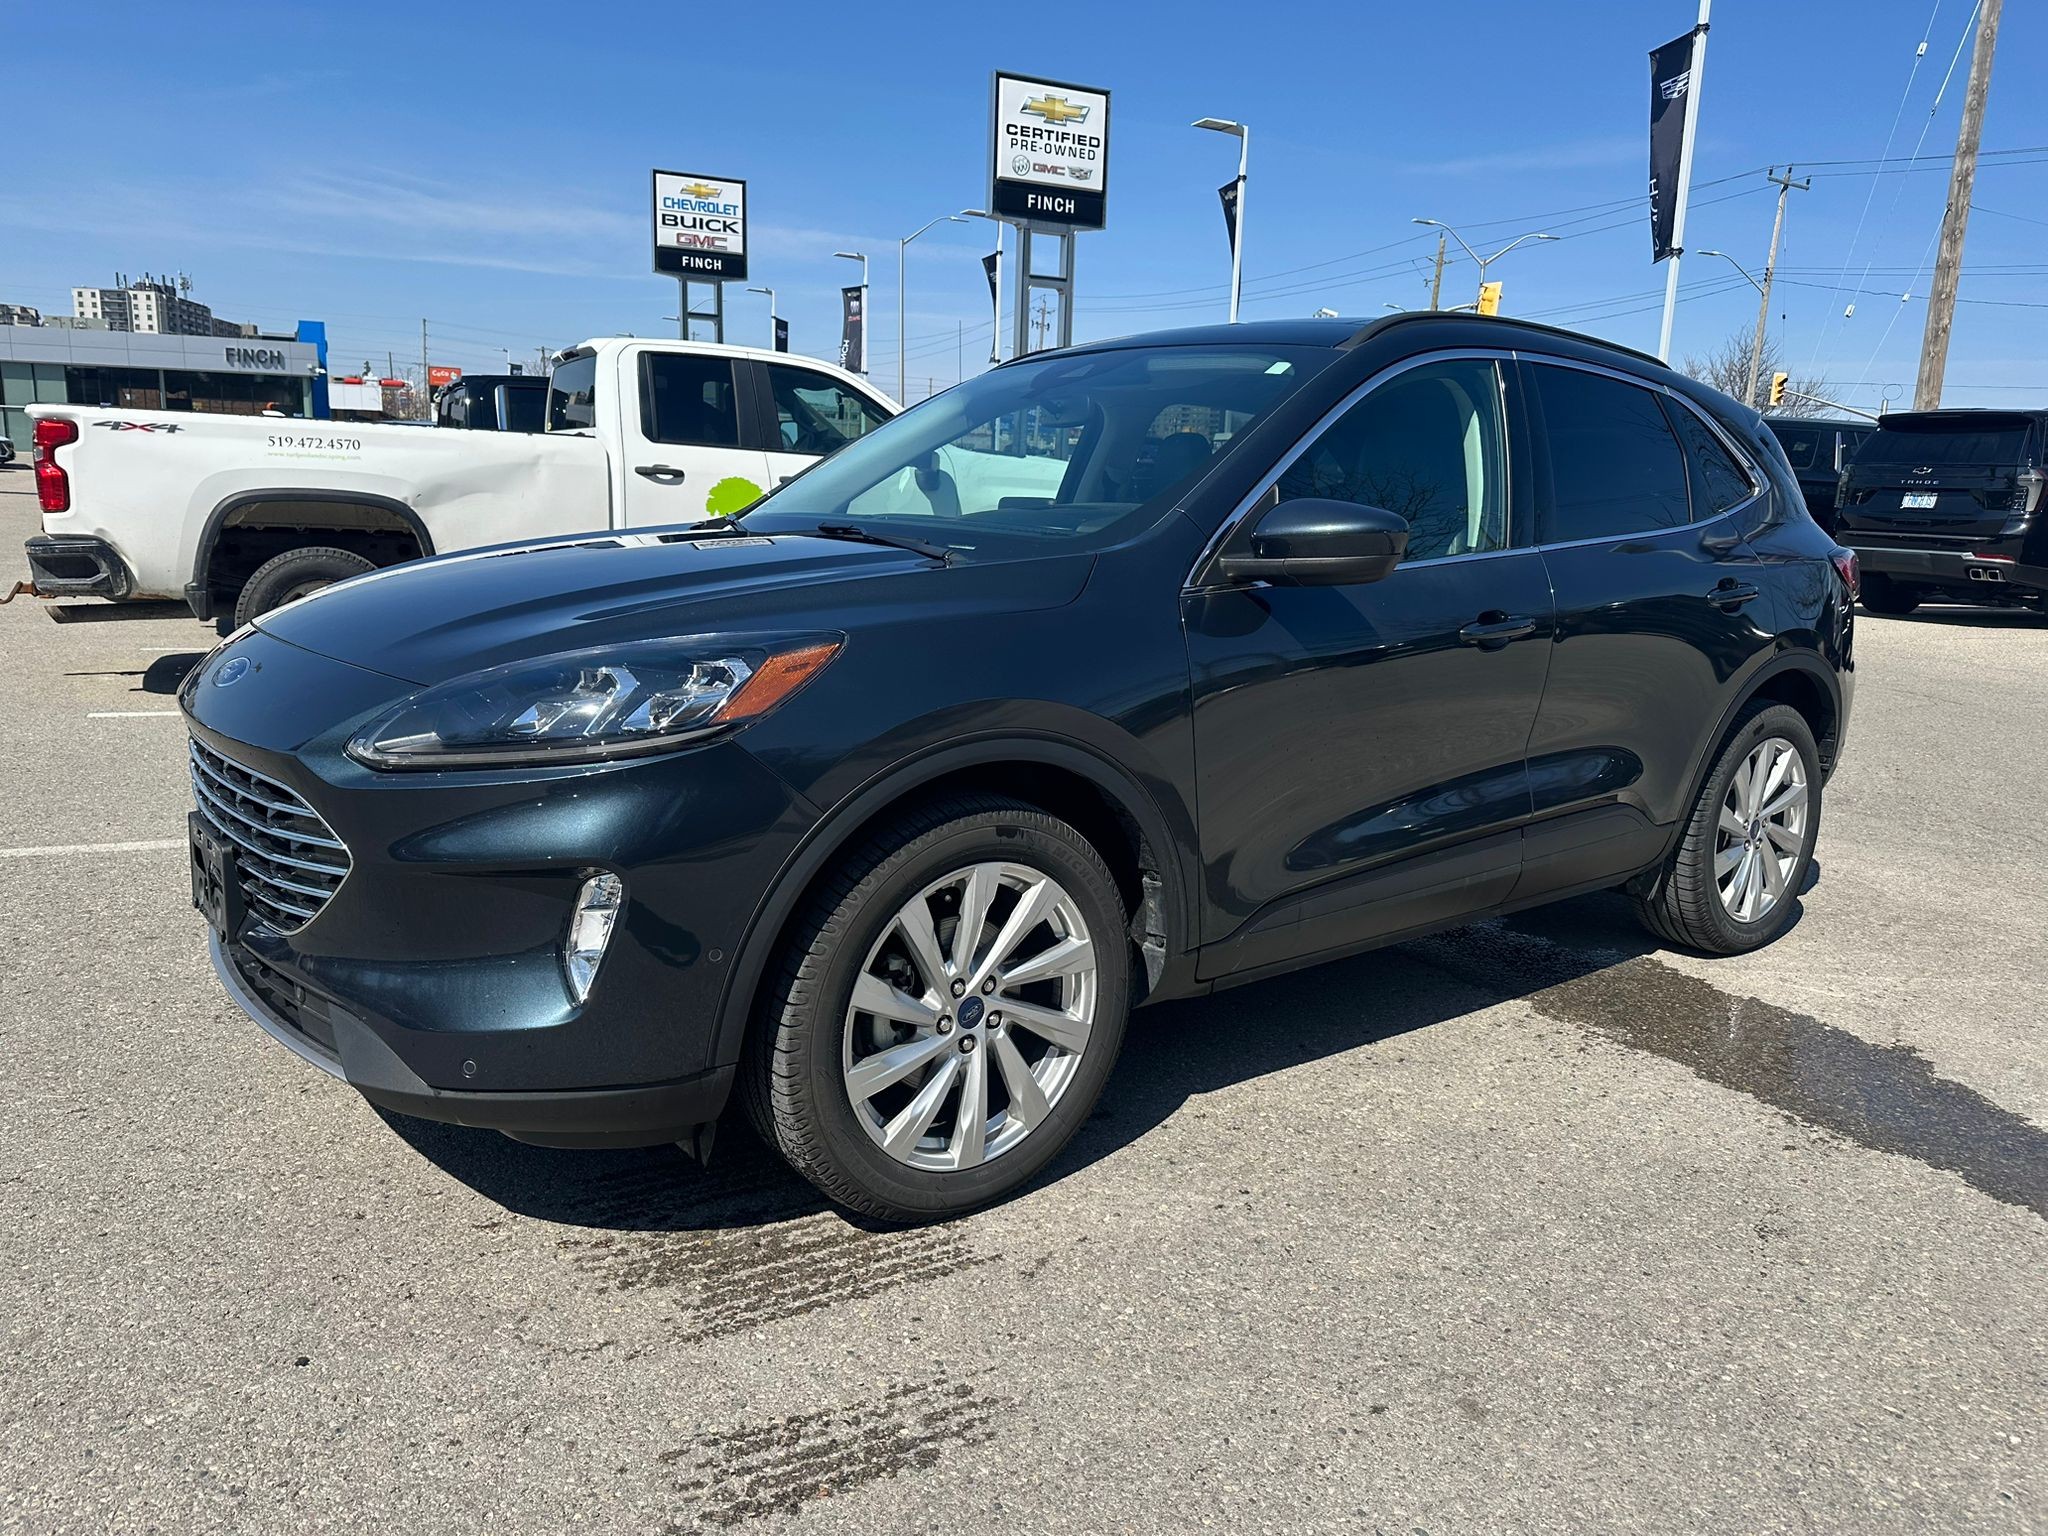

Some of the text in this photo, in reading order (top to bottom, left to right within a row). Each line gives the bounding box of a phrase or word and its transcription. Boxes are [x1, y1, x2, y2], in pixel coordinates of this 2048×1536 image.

[1006, 123, 1101, 149] CERTIFIED
[1010, 138, 1096, 161] PRE-OWNED
[1032, 162, 1066, 176] GMC
[663, 196, 739, 216] CHEVROLET
[1027, 194, 1075, 214] FINCH
[661, 213, 740, 234] BUICK
[676, 232, 728, 250] GMC
[682, 256, 722, 270] FINCH
[225, 347, 281, 365] FINCH
[267, 435, 361, 451] 519.472.4570
